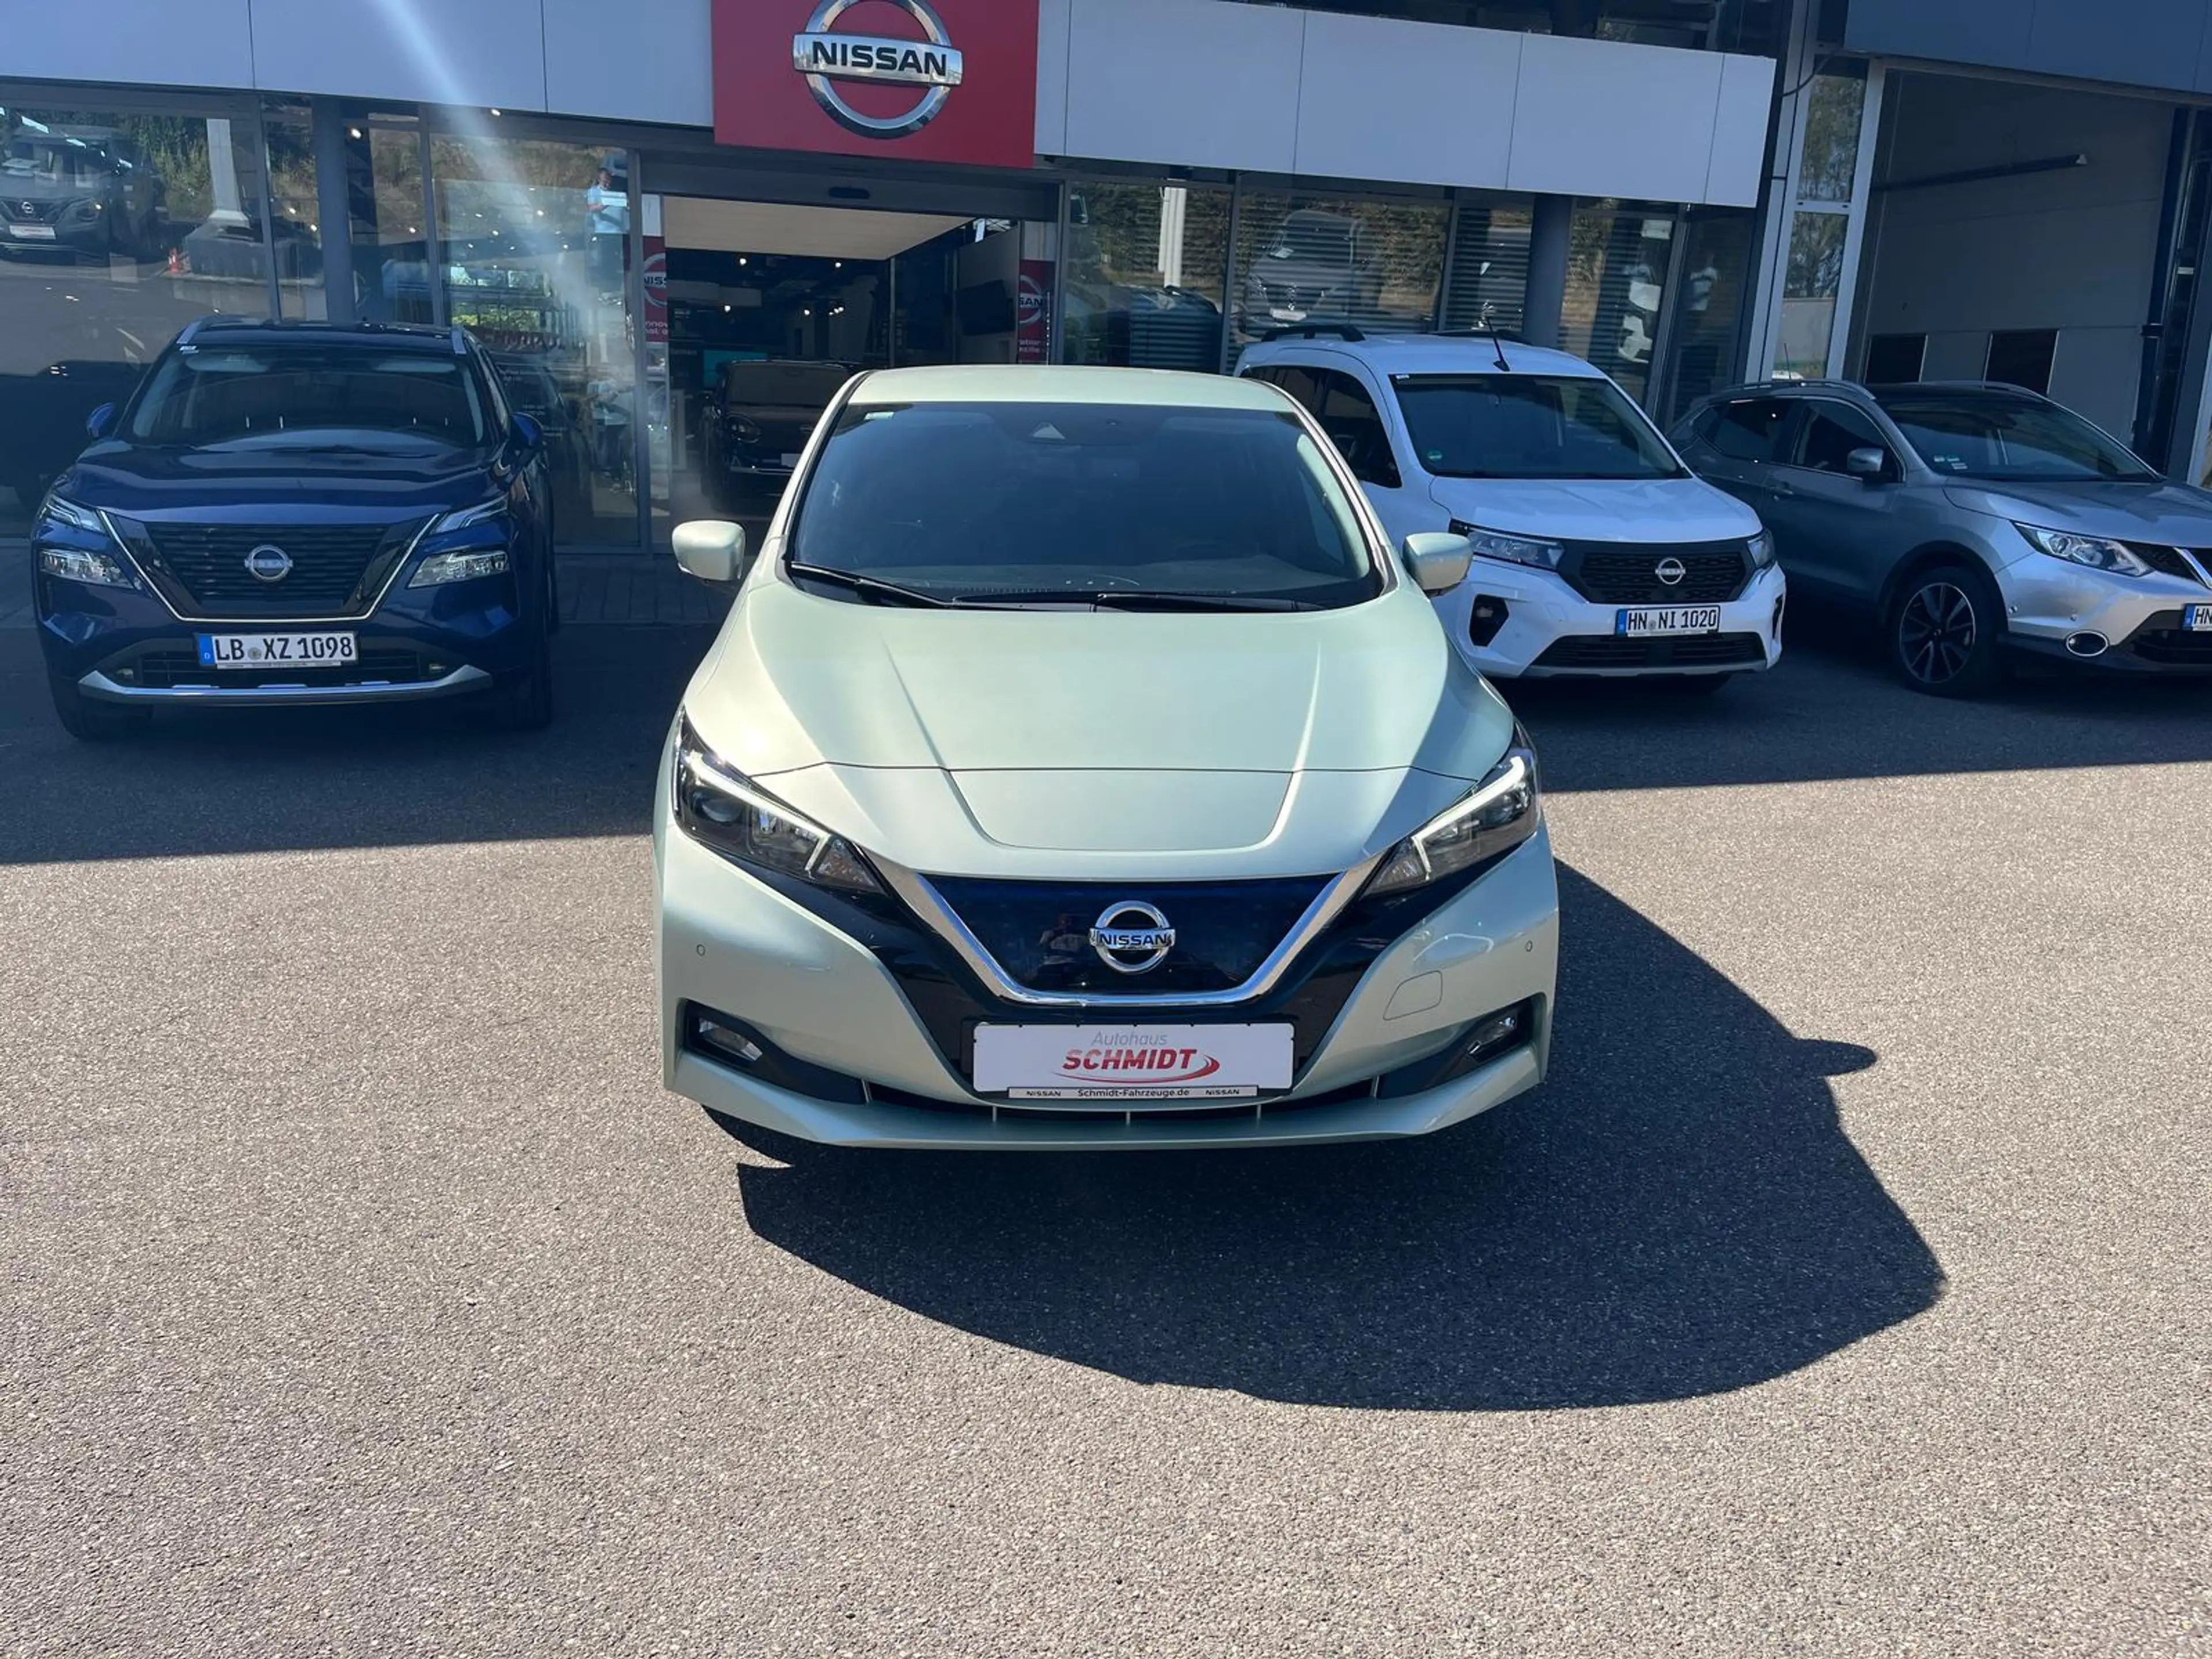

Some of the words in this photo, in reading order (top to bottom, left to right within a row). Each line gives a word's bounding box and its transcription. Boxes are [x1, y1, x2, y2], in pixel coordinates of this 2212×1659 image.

[812, 41, 946, 76] NISSAN
[1628, 612, 1647, 630] HN
[1658, 611, 1676, 629] NI
[1681, 609, 1717, 628] 1020
[2194, 608, 2212, 624] HN
[215, 638, 245, 660] LB
[263, 638, 292, 660] XZ
[297, 637, 353, 659] 1098
[1100, 933, 1167, 945] NISSAN
[1091, 1031, 1168, 1046] Autohaus
[1062, 1048, 1197, 1070] SCHMIDT
[1078, 1089, 1190, 1100] Schmidt-Fahrzeuge.de
